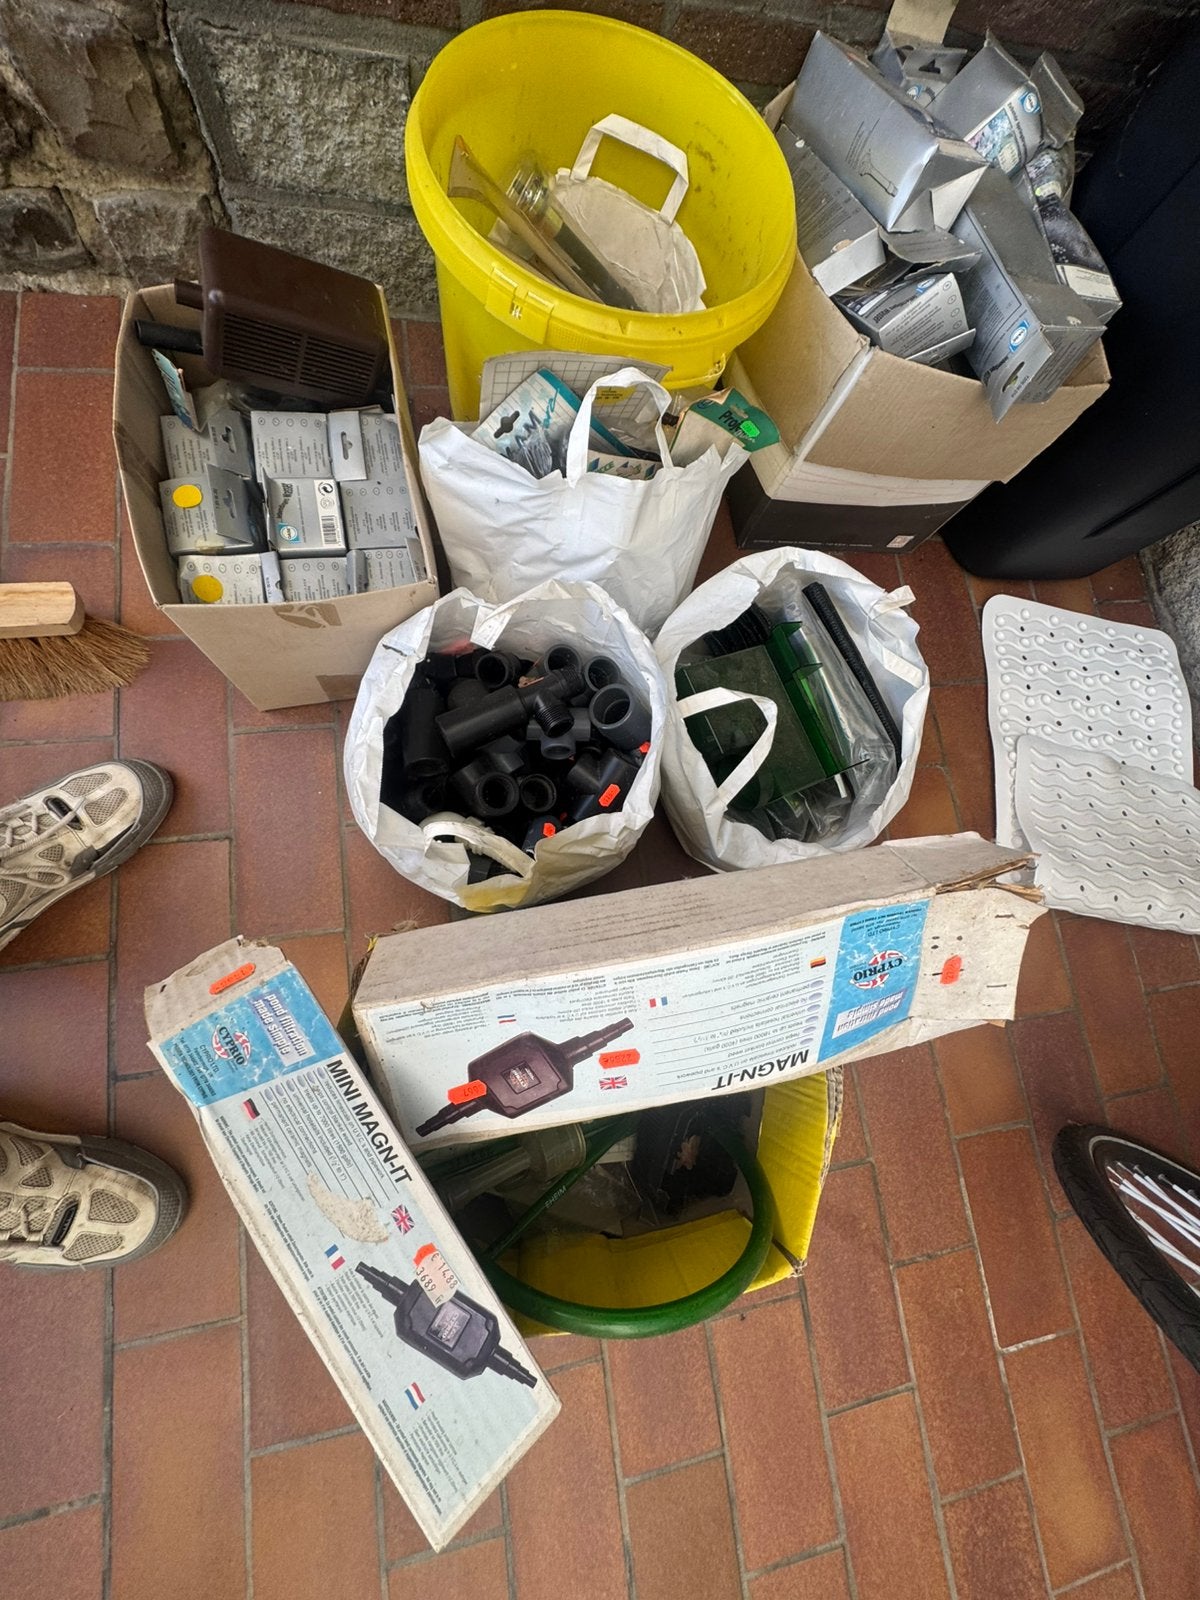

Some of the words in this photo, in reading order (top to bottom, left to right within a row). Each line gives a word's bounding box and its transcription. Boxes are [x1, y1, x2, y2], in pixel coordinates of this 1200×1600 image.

[853, 957, 902, 981] CYPRIO
[251, 997, 275, 1026] made
[264, 1021, 292, 1057] simple
[264, 990, 288, 1018] pond
[277, 1013, 310, 1057] filtration
[216, 1025, 246, 1066] CYPRIO
[323, 1079, 338, 1100] reduces
[708, 1047, 811, 1091] MAGN-IT
[285, 1103, 302, 1126] electrical
[297, 1124, 318, 1154] connections
[291, 1092, 308, 1115] universal
[316, 1134, 333, 1156] included
[302, 1088, 315, 1103] treats
[318, 1114, 330, 1128] 7000
[321, 1097, 335, 1116] control
[330, 1114, 345, 1133] blanket
[341, 1131, 352, 1146] weed
[325, 1057, 362, 1103] MINI
[351, 1099, 412, 1188] MAGN-IT
[269, 1100, 289, 1128] permanent
[285, 1126, 300, 1147] ceramic
[295, 1145, 312, 1169] magnets
[363, 1146, 373, 1158] and
[367, 1156, 385, 1179] pipework
[414, 1265, 437, 1293] 3689
[436, 1261, 459, 1289] 14.88
